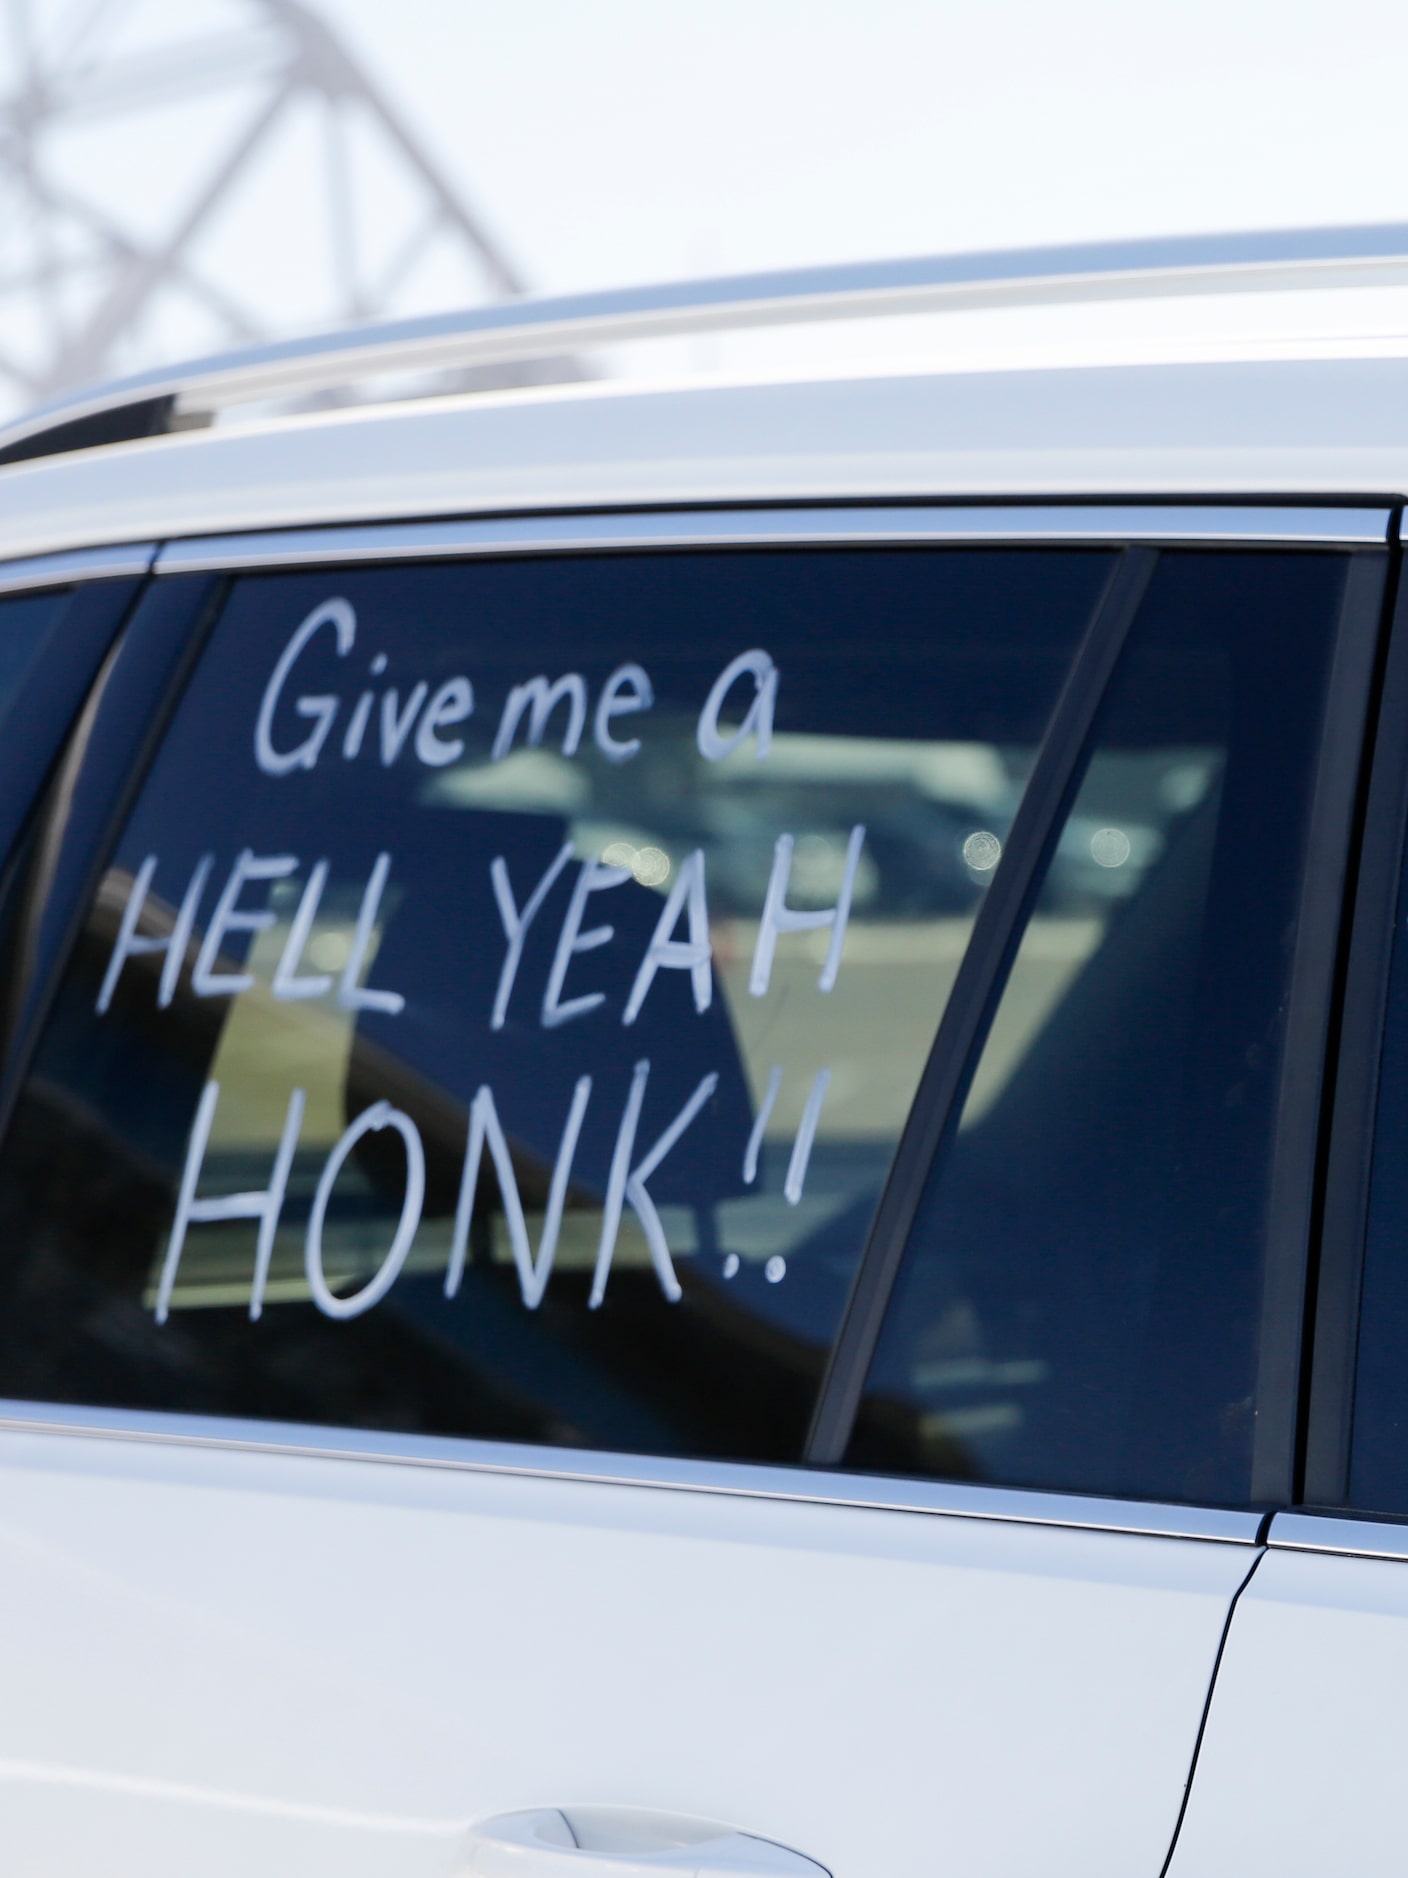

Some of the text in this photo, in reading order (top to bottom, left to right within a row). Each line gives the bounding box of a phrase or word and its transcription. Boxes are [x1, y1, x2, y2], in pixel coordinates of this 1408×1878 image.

[254, 598, 779, 776] Give me a
[95, 825, 866, 1029] HELL YEAH
[154, 1059, 832, 1325] HONK!!
